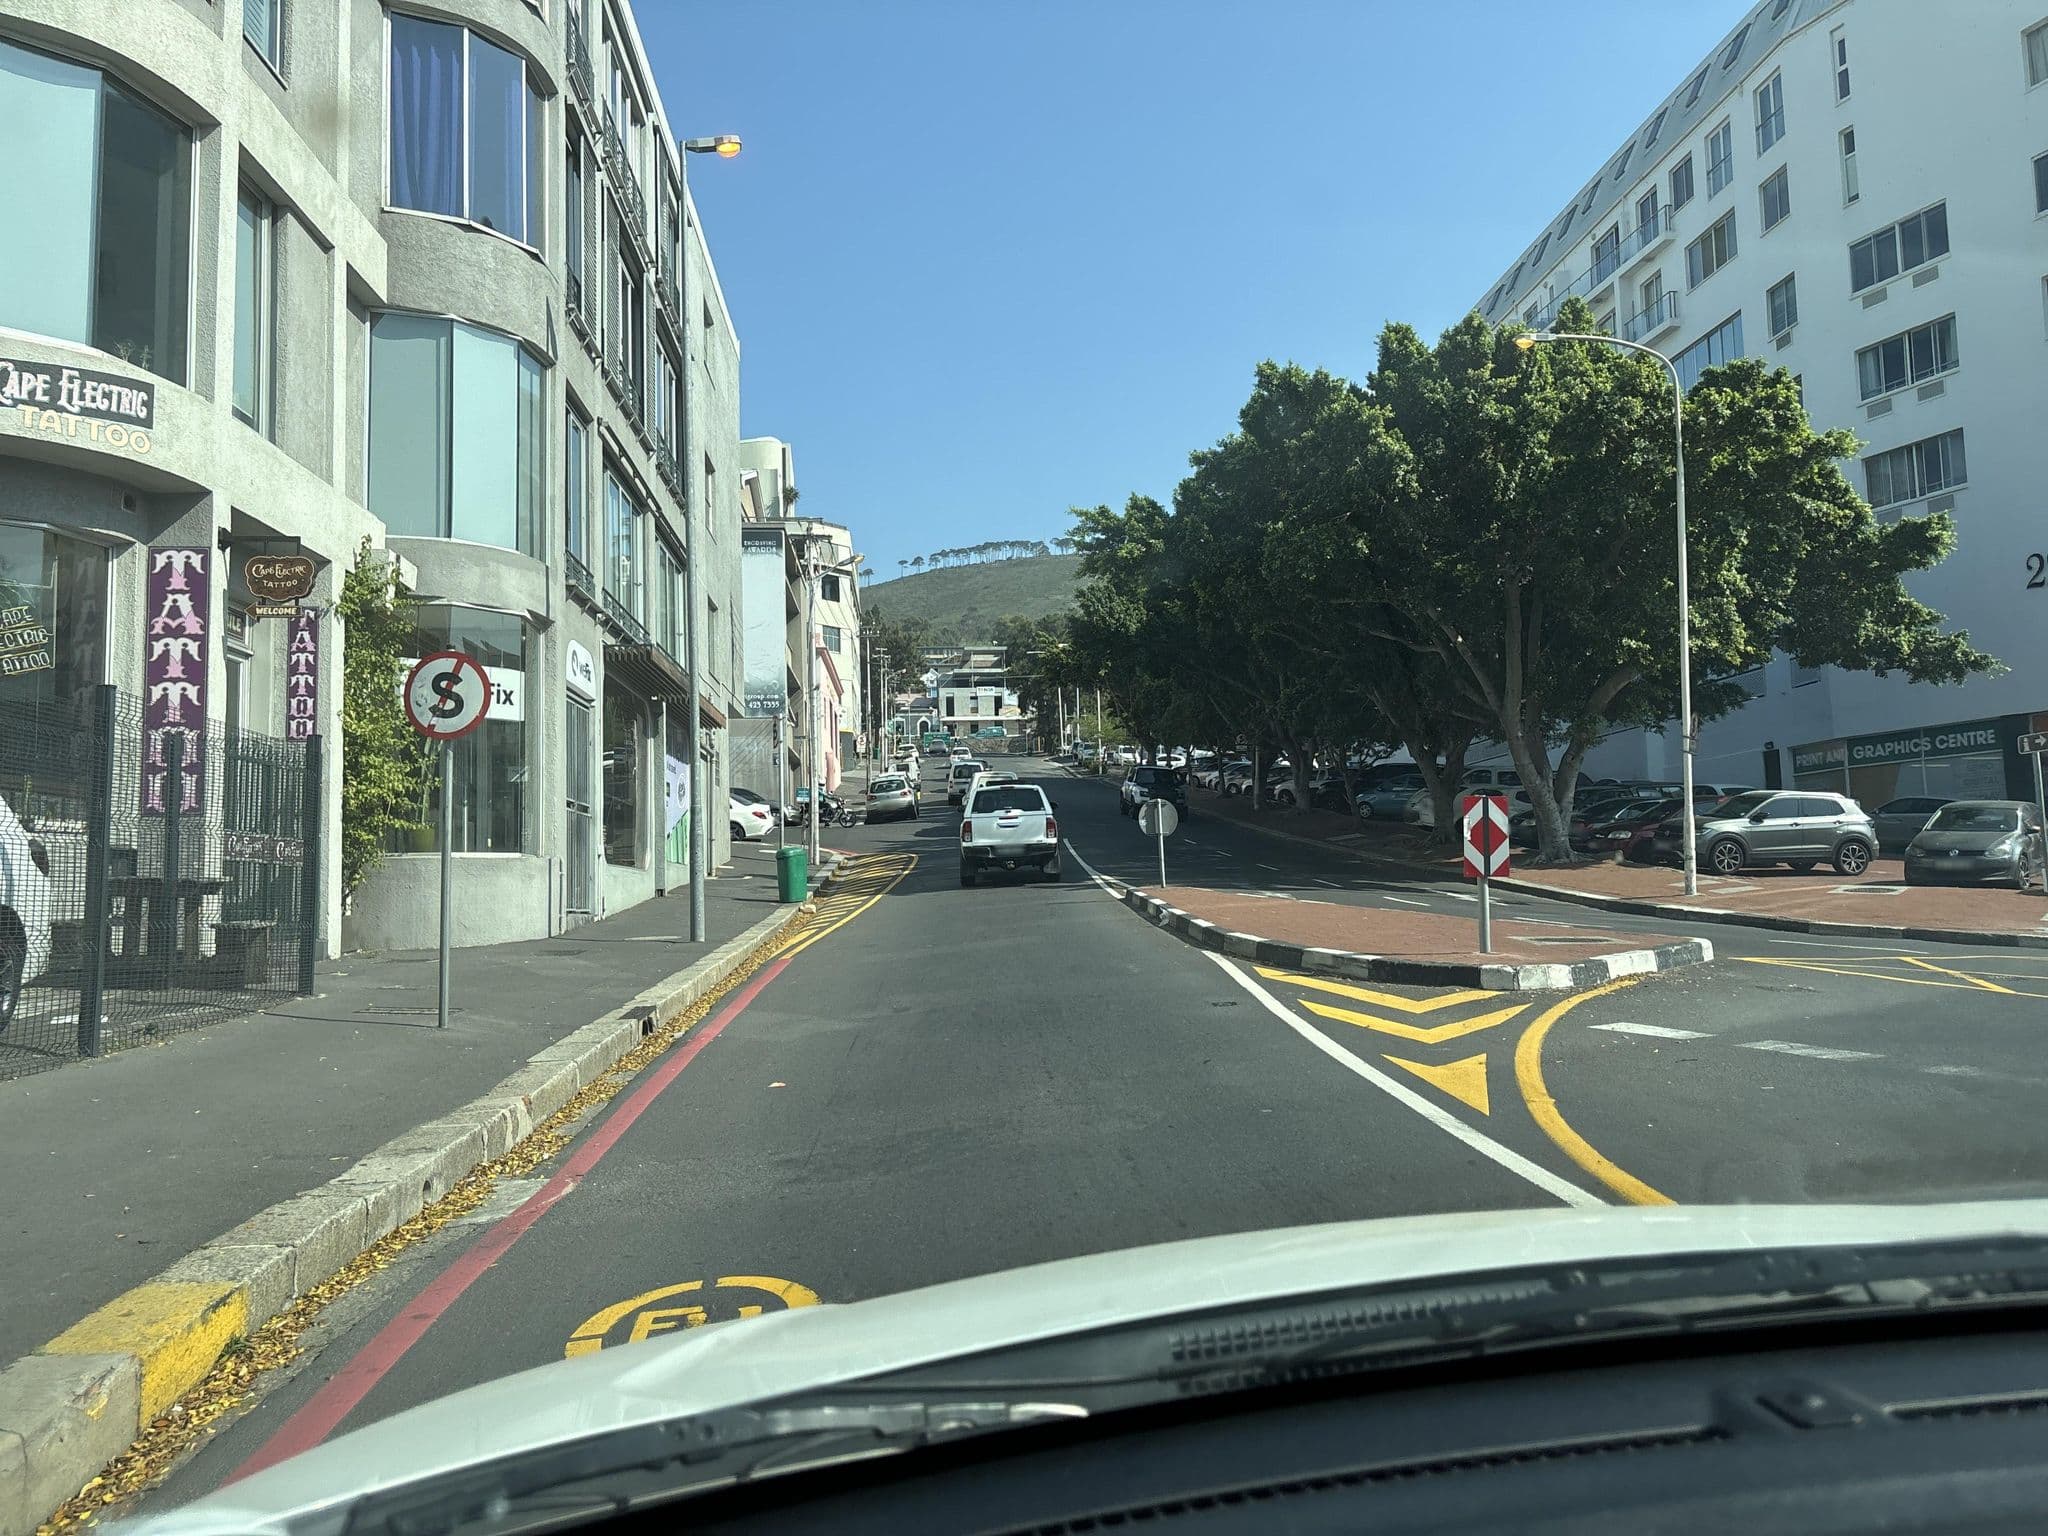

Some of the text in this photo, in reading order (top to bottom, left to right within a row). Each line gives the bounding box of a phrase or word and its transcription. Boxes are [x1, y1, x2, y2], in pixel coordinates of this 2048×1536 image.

[57, 368, 149, 419] ELECTRIC
[16, 404, 151, 454] TATTOO
[263, 579, 298, 588] TATTOO
[2026, 553, 2048, 590] 2
[255, 607, 298, 615] WELCOME
[428, 671, 465, 719] S
[1852, 736, 1932, 760] GRAPHICS
[1935, 729, 1997, 750] CENTRE
